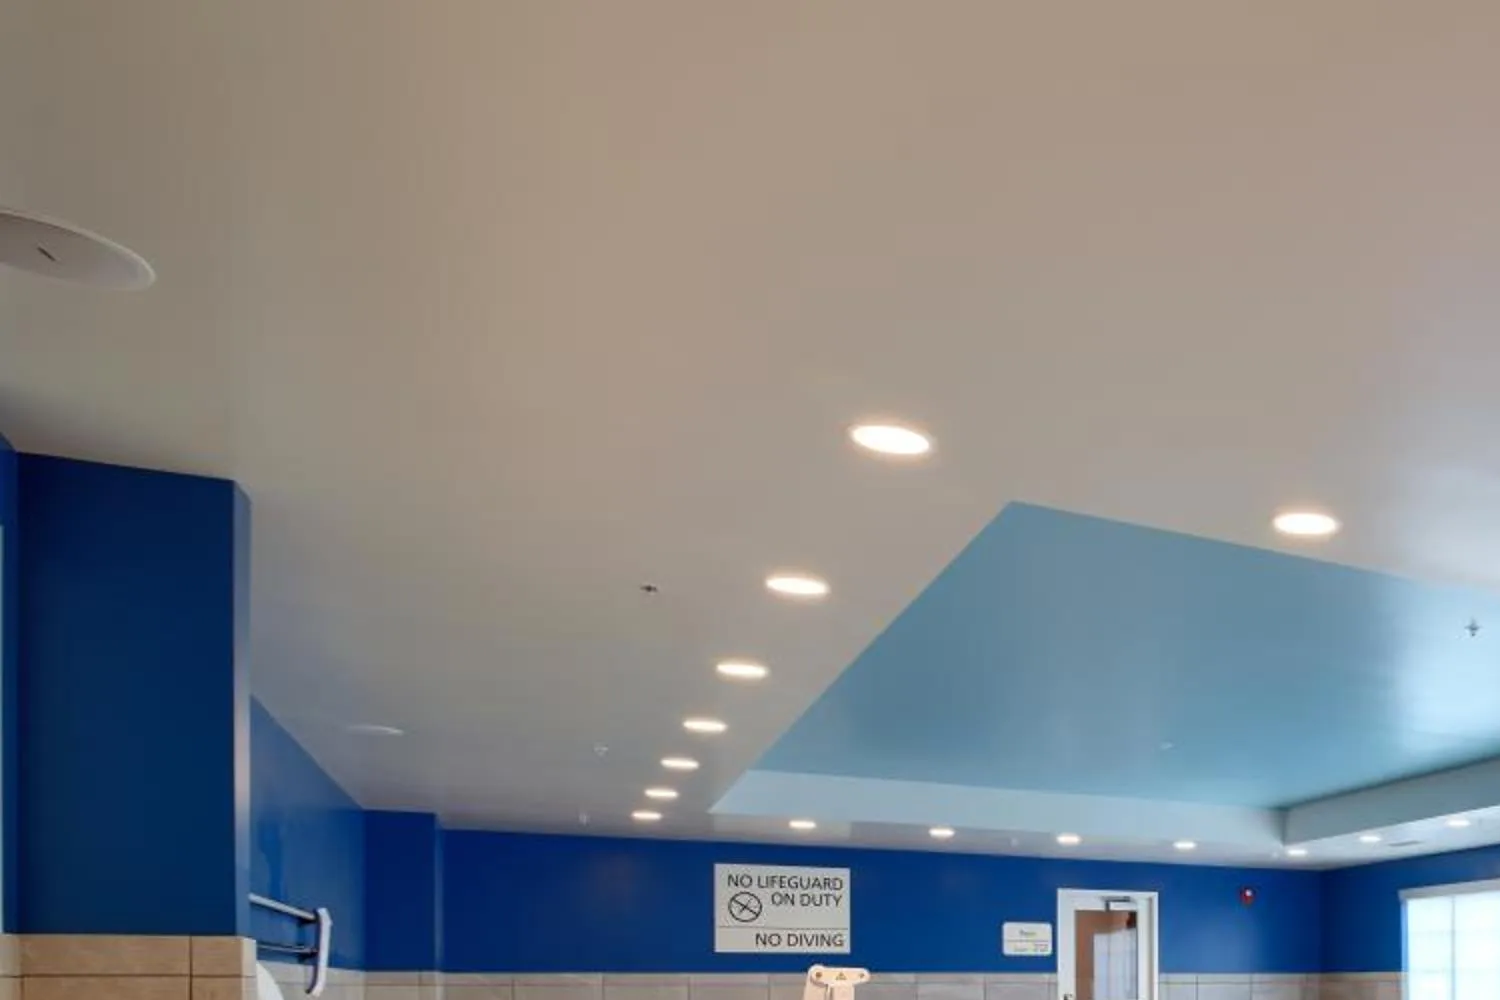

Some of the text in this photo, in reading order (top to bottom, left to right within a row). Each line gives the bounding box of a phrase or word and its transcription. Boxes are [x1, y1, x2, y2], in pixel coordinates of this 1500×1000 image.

[727, 874, 843, 891] NO LIFEGUARD
[771, 891, 843, 907] ON DUTY
[755, 933, 844, 947] NO DIVING
